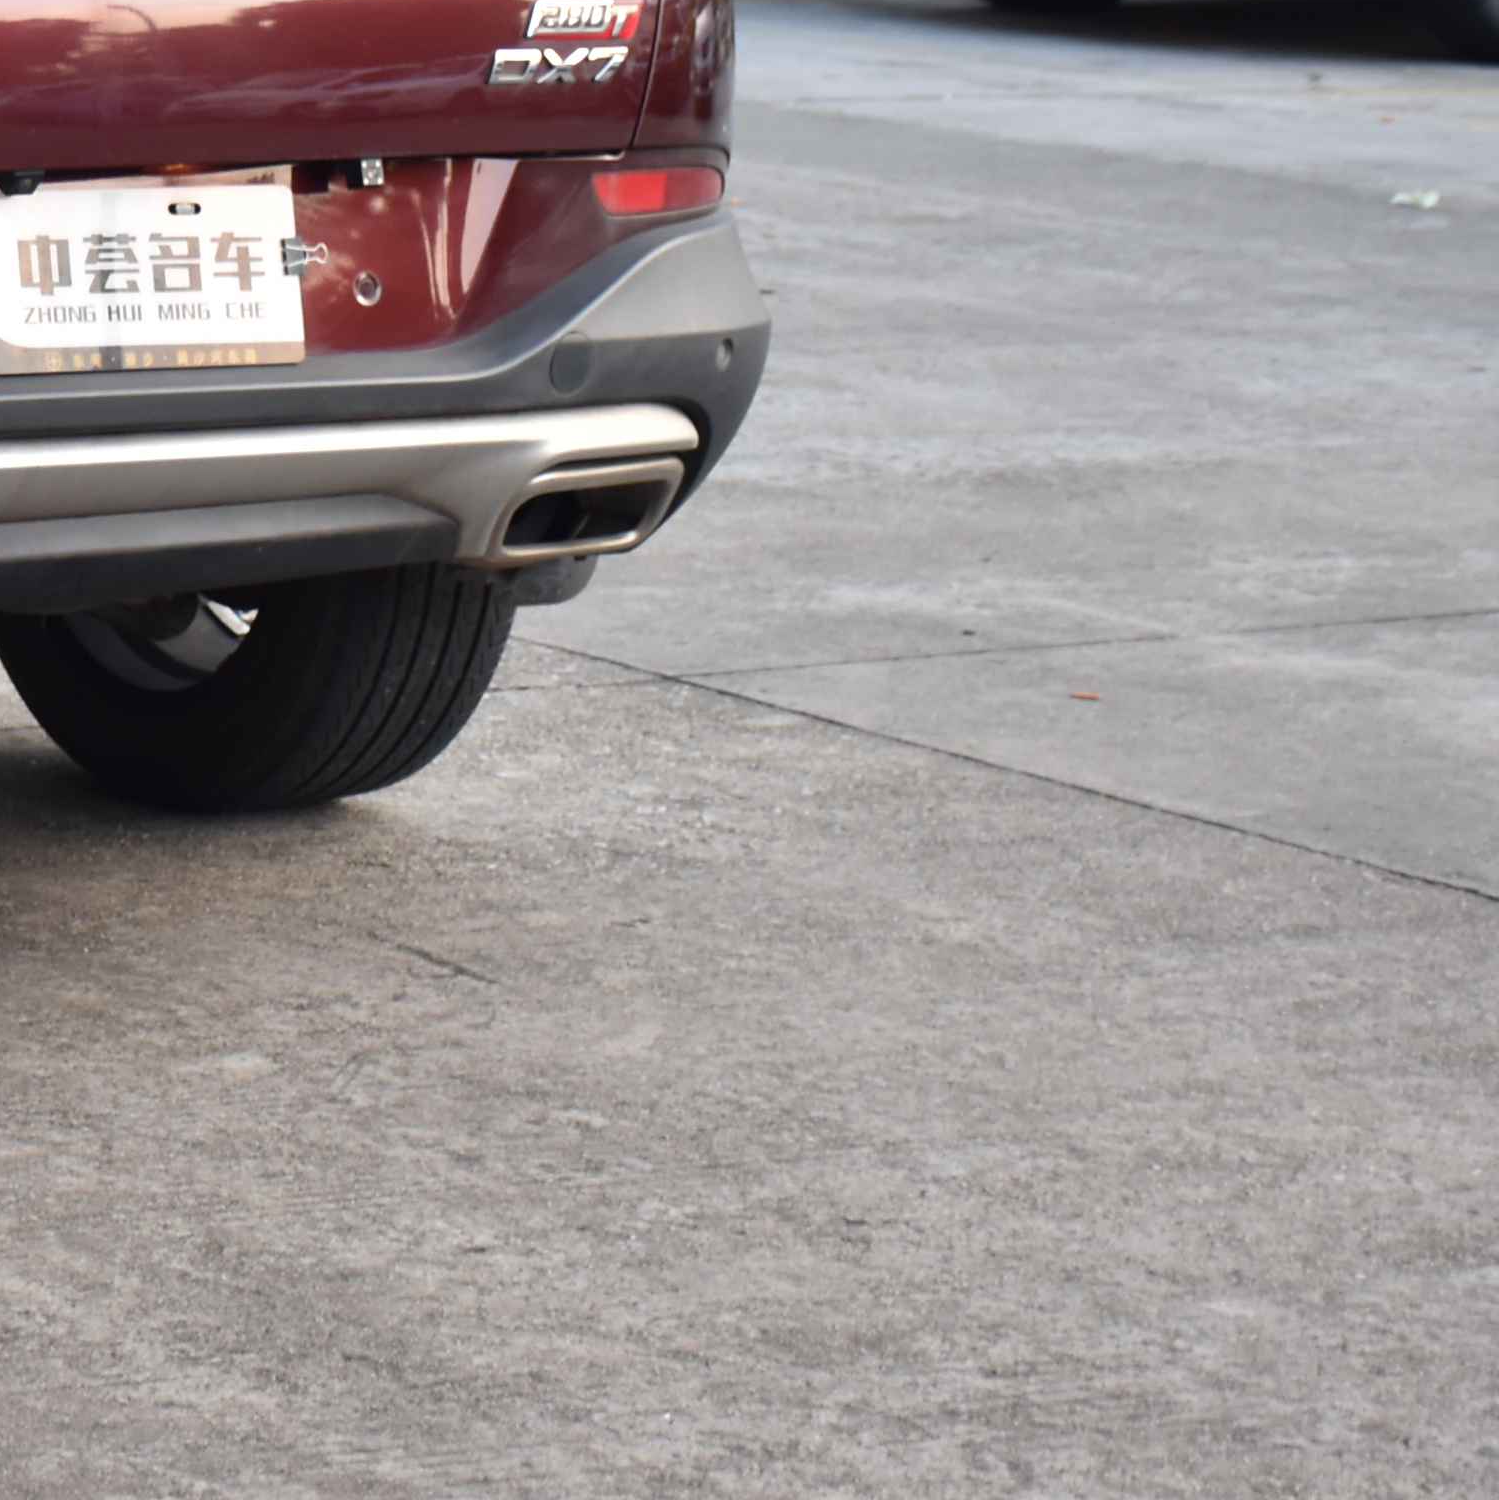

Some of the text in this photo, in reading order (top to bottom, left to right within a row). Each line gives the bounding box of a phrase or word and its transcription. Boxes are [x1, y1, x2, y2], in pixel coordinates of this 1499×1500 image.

[487, 46, 629, 85] DX7
[17, 232, 265, 296] 中荟名车
[23, 300, 268, 325] ZHONG HUI MING CHE
